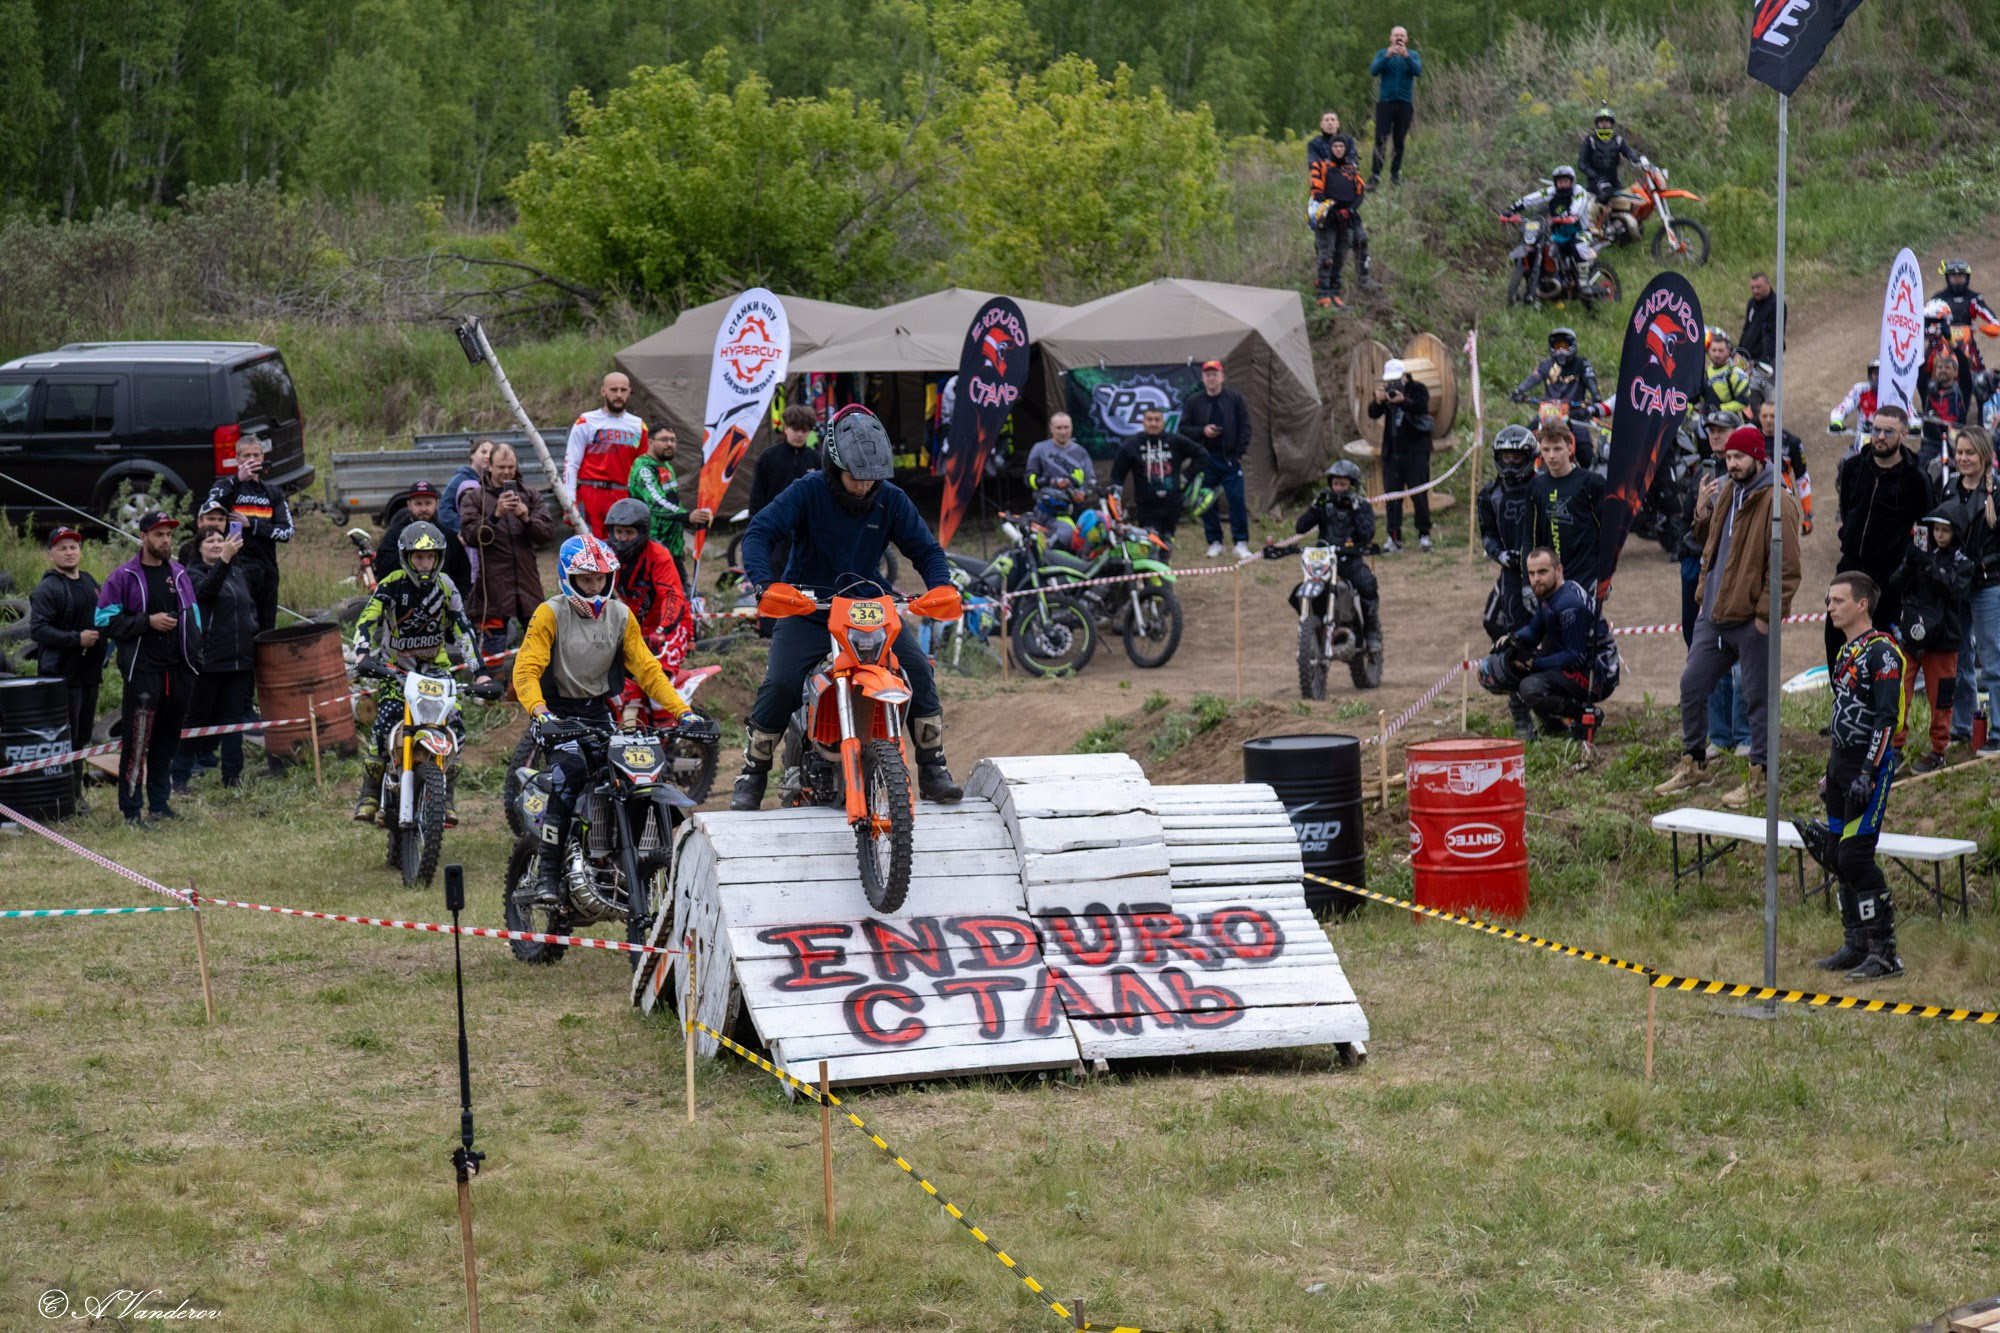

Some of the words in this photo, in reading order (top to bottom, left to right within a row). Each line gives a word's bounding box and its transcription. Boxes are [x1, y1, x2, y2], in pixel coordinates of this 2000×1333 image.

[1752, 0, 1811, 47] VE
[728, 301, 759, 335] СТАНКИ
[761, 302, 777, 322] ЧПУ
[1633, 288, 1700, 343] ENDURO
[1886, 313, 1921, 335] HYPERCUT
[971, 307, 1026, 347] ENDURO
[720, 345, 783, 359] HYPERCUT
[827, 421, 840, 462] 100%
[859, 609, 876, 620] 34
[391, 632, 445, 650] MOTOCROSS
[424, 682, 437, 693] 94
[5, 739, 73, 761] RECOR
[632, 753, 646, 763] 14
[1300, 841, 1329, 852] DIO
[1446, 832, 1502, 847] SINTEC
[757, 902, 1285, 992] ENDURO
